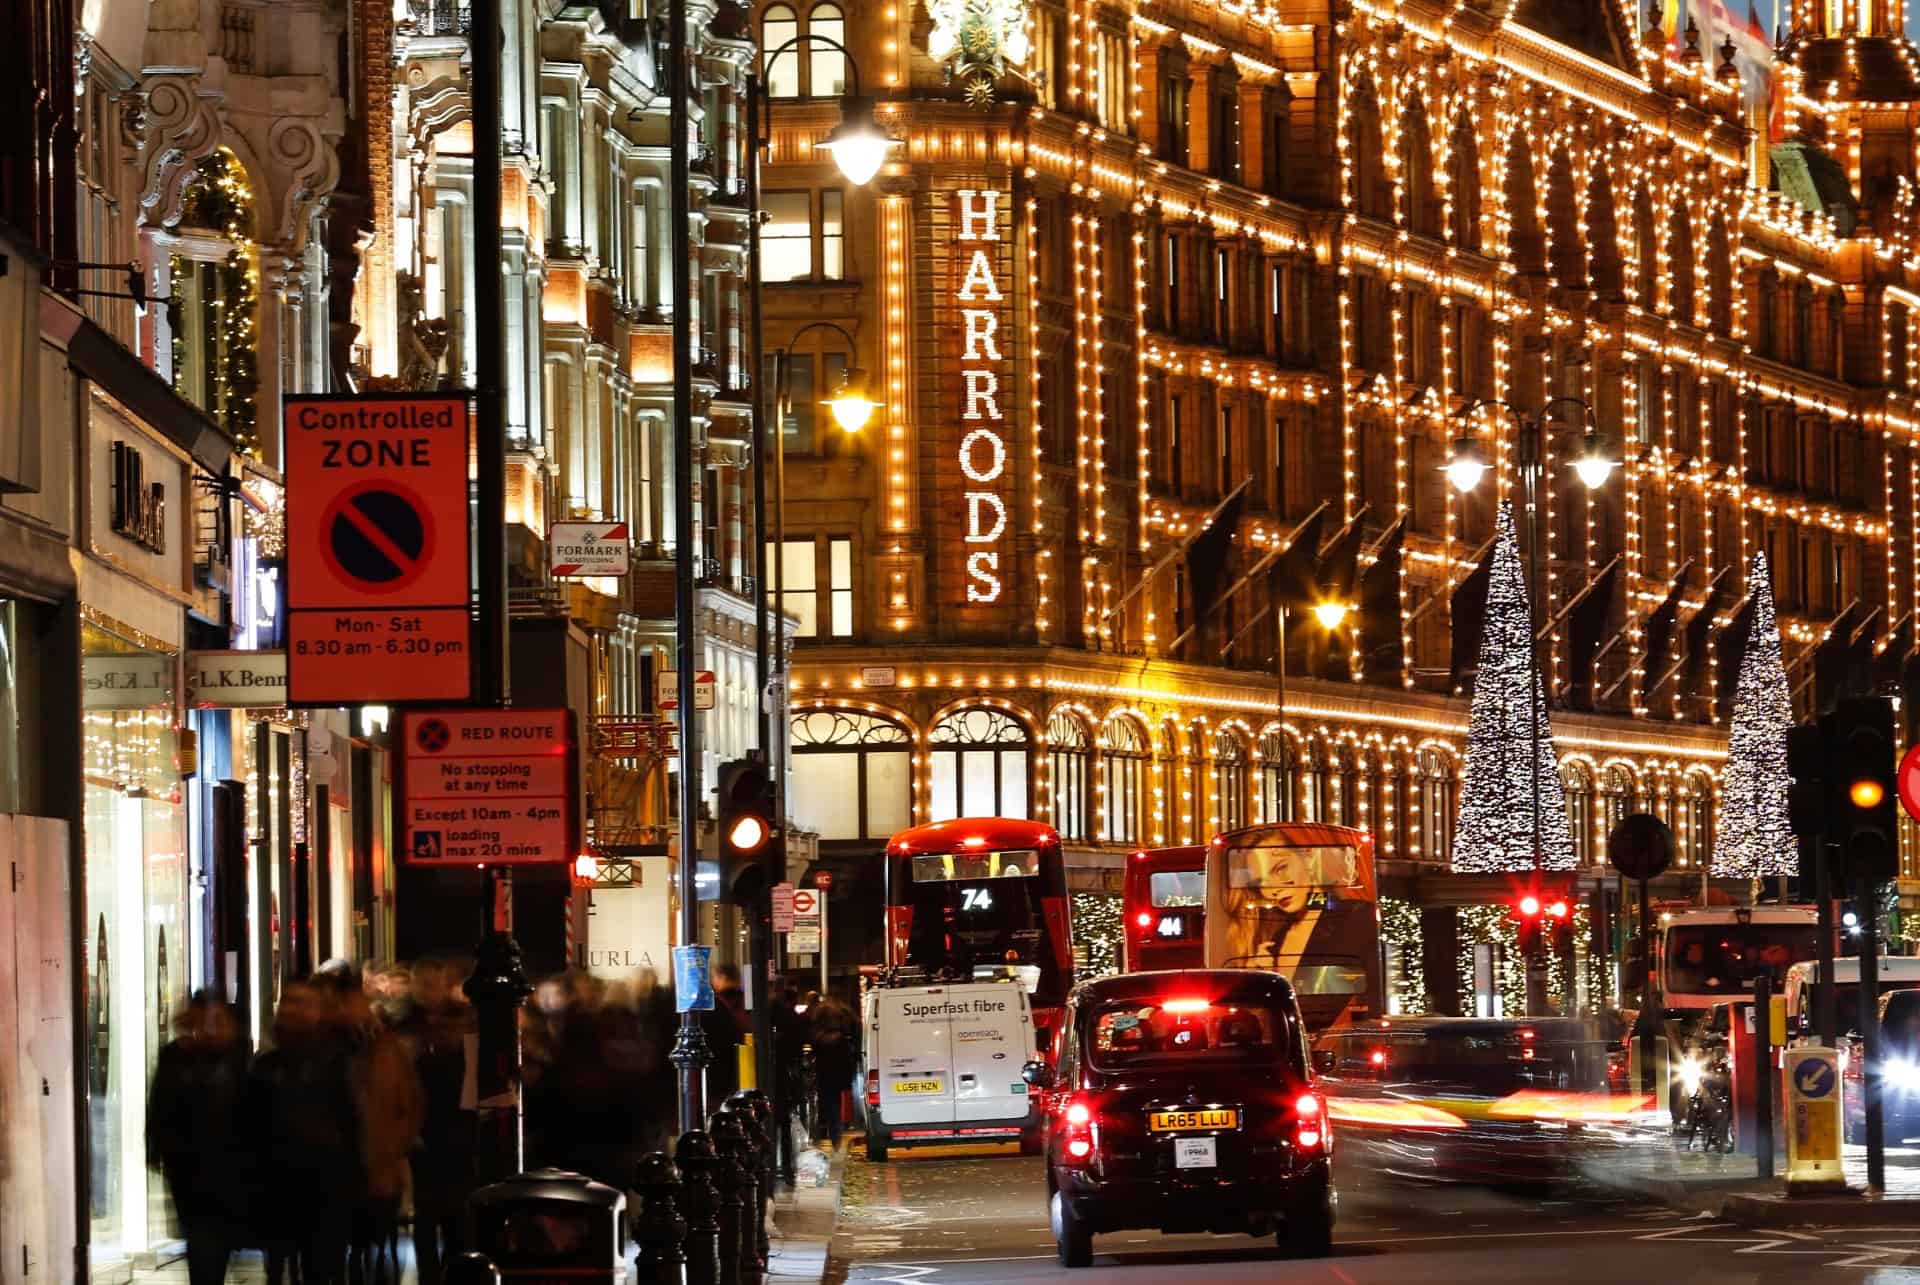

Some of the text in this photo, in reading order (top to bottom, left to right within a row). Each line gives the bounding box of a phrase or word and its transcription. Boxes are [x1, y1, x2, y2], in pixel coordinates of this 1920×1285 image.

[956, 189, 1008, 603] HARRODS
[299, 405, 453, 430] Controlled
[322, 438, 431, 468] ZONE
[557, 545, 622, 555] FORMARK
[389, 616, 423, 632] Sat
[296, 639, 341, 655] 8.30
[344, 643, 372, 655] am
[386, 637, 430, 654] 6.30
[434, 640, 463, 656] pm
[461, 726, 553, 740] RED ROUTE
[441, 762, 531, 777] No stopping
[445, 777, 529, 793] at any time
[414, 808, 467, 821] Except
[472, 807, 512, 820] 10am
[527, 806, 561, 821] 4pm
[446, 829, 501, 842] loading
[446, 843, 542, 857] max 20 mins
[961, 888, 992, 911] 74
[903, 999, 1006, 1018] Superfast fibre
[1157, 1111, 1230, 1129] LR65 LLU
